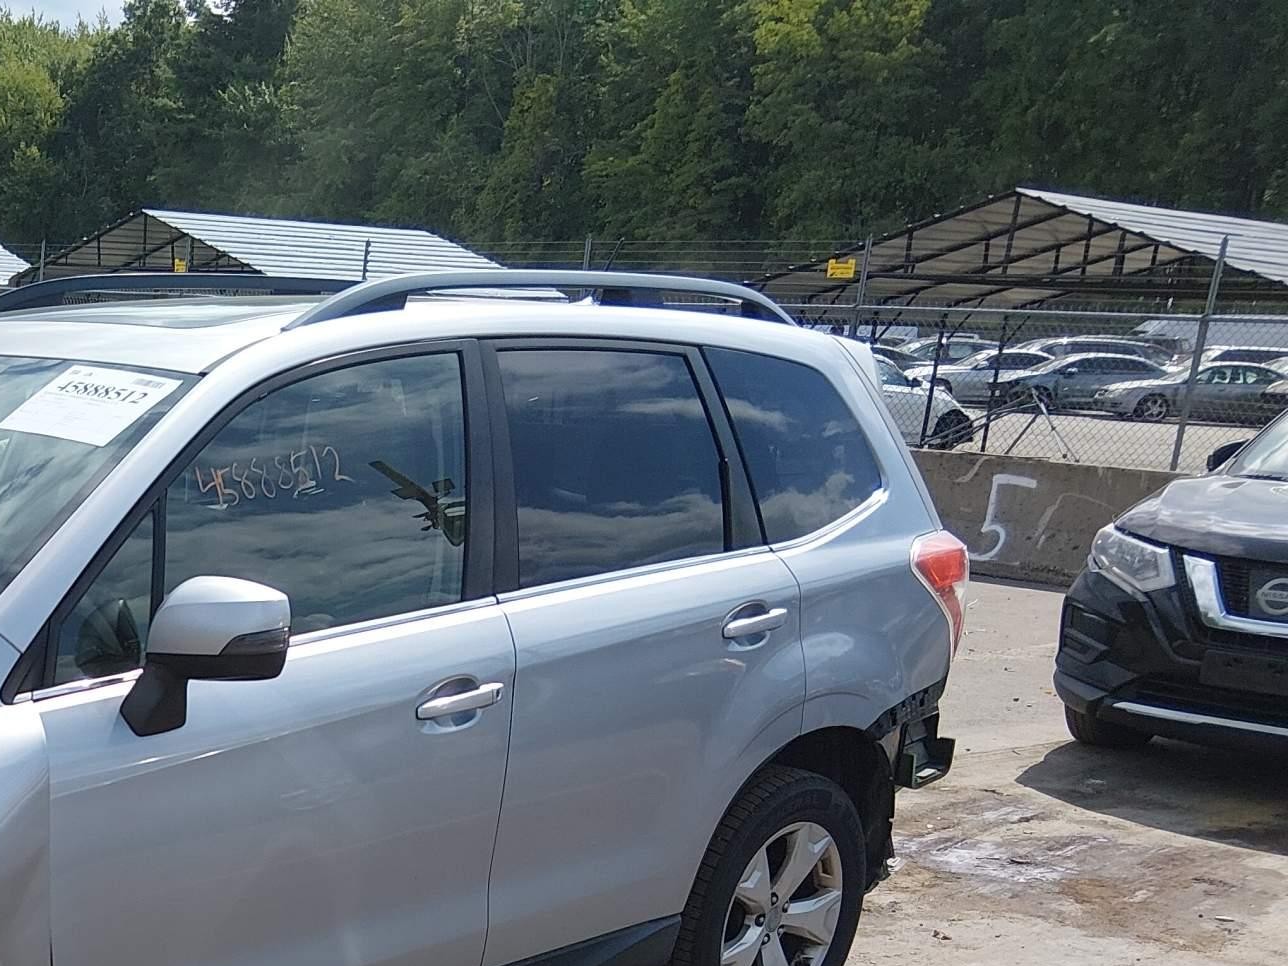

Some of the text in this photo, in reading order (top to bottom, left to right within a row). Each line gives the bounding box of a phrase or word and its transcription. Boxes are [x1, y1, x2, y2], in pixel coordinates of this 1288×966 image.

[57, 380, 149, 405] 45888512
[195, 445, 355, 506] 45888512
[967, 473, 1038, 562] 5
